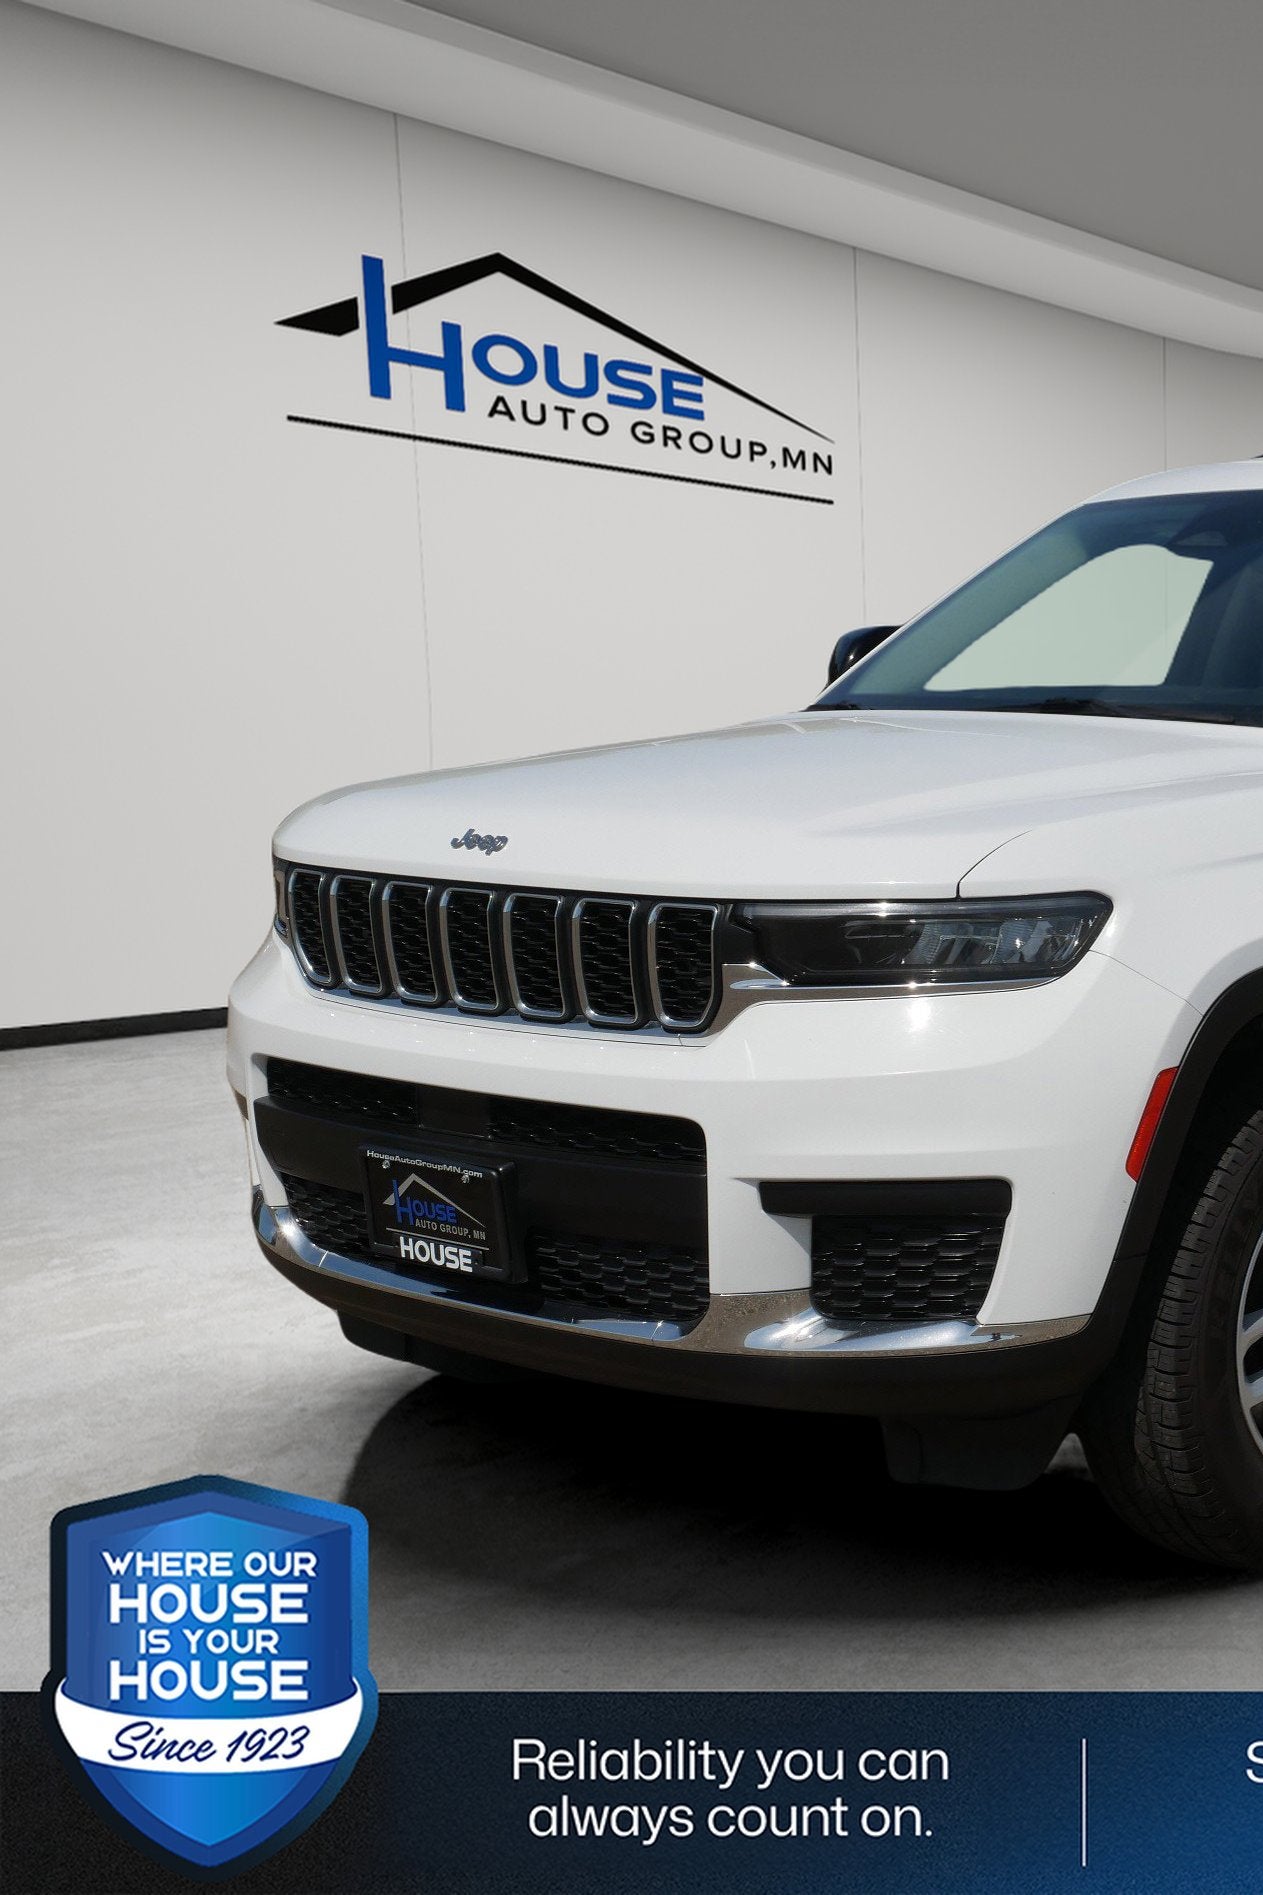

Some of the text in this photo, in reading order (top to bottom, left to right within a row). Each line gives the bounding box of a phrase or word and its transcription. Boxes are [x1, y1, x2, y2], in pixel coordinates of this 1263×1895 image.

[362, 254, 705, 421] HOUSE
[487, 395, 610, 437] AUTO
[450, 828, 508, 856] Jeep
[392, 1178, 458, 1226] HOUSE
[415, 1218, 438, 1231] AUTO
[399, 1236, 473, 1273] HOUSE
